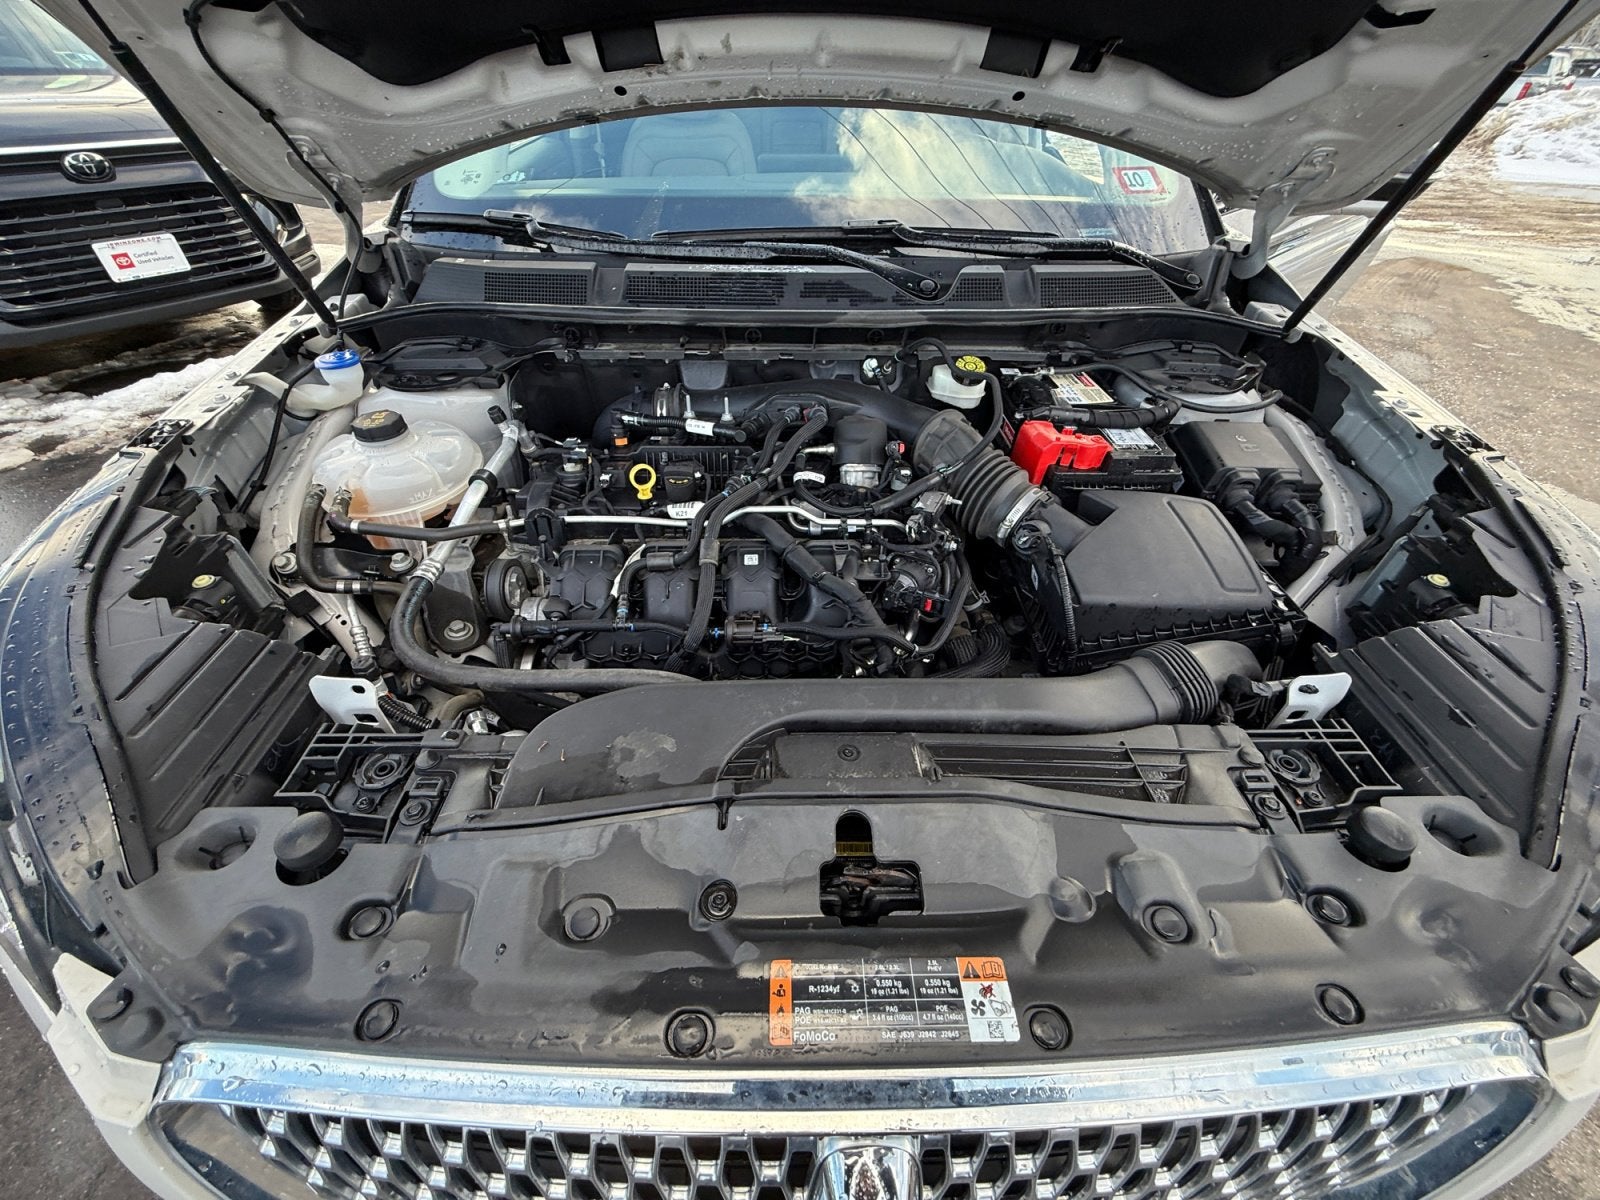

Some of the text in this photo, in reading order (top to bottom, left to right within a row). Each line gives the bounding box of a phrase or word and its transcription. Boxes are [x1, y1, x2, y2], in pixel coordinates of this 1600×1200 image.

[1123, 171, 1145, 187] 10
[133, 250, 158, 258] Certified
[875, 978, 902, 988] 0.550 kg
[924, 978, 951, 988] 0.550 kg
[808, 984, 840, 994] R-1234yf
[794, 1006, 811, 1015] PAG
[885, 1005, 899, 1013] PAG
[795, 1016, 811, 1024] POE
[793, 1030, 836, 1042] FoMoCo
[881, 1031, 897, 1039] SAE
